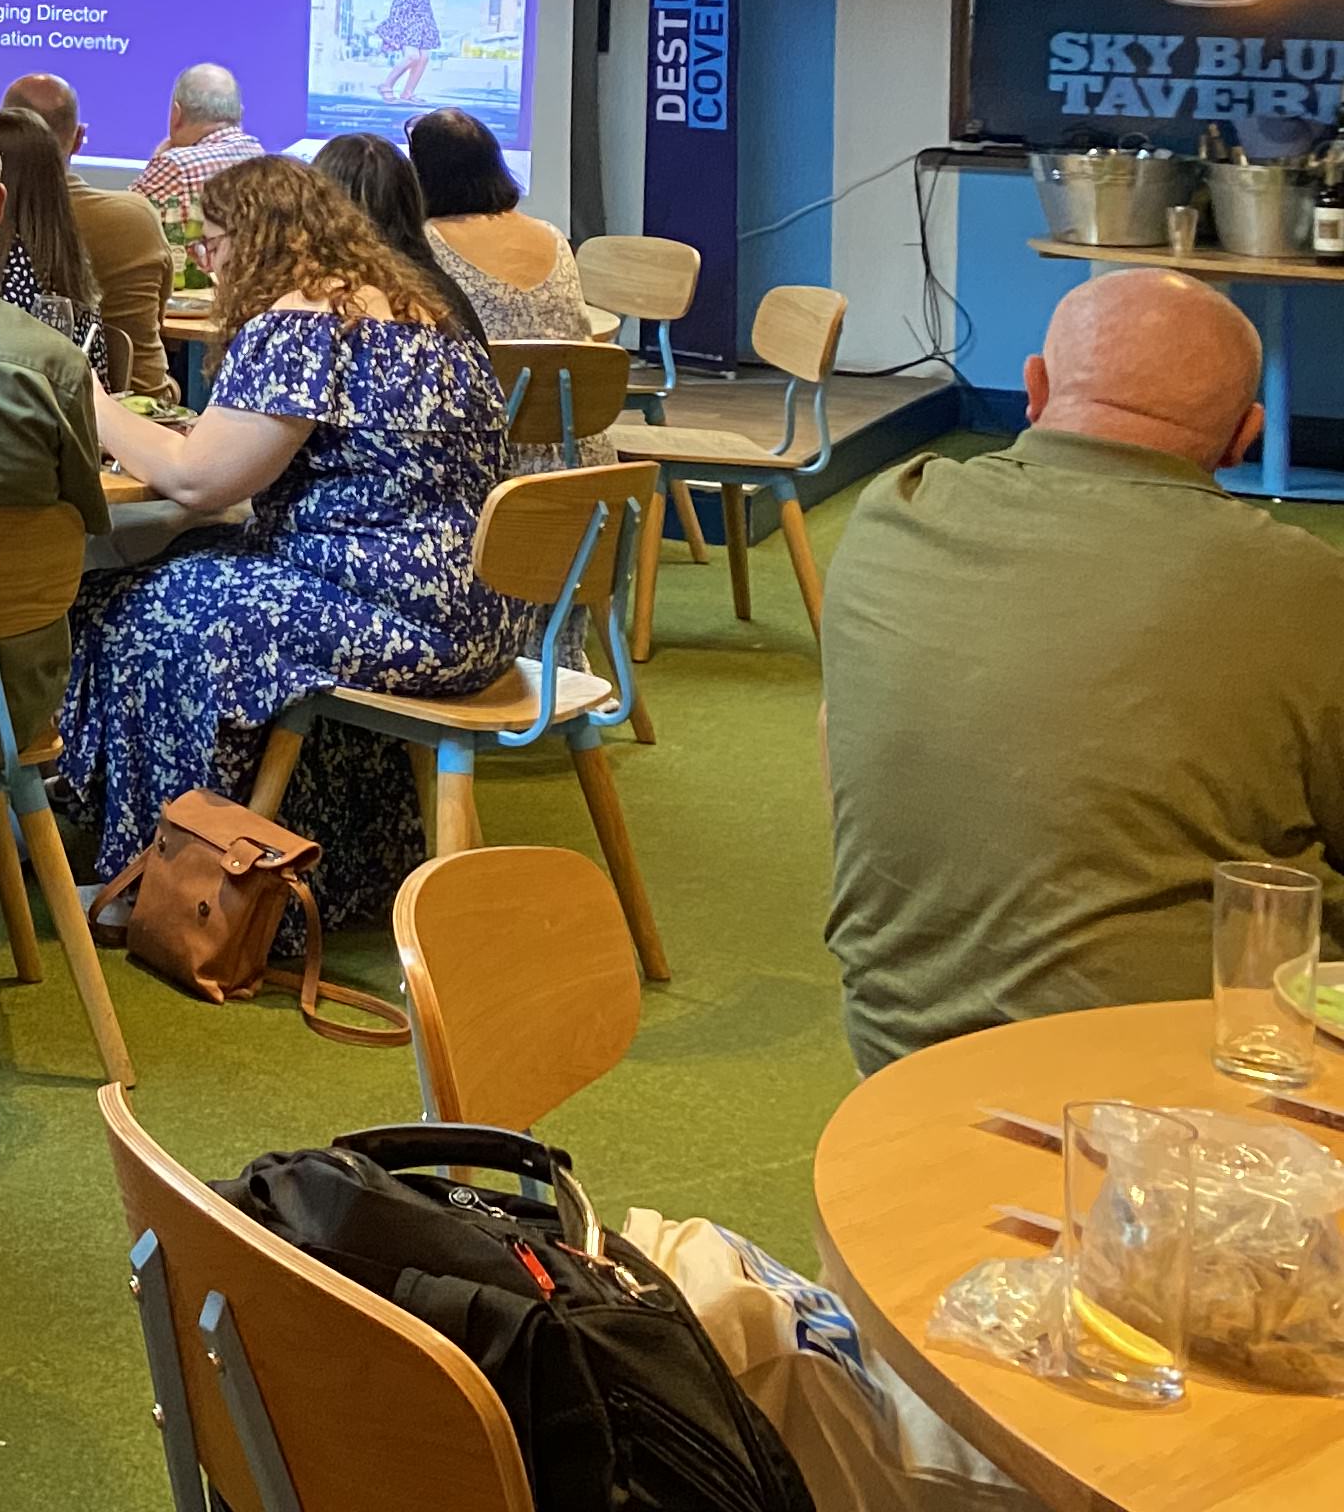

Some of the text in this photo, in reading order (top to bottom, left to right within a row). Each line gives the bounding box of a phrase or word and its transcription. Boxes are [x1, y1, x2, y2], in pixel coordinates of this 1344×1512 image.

[37, 4, 108, 23] Director
[48, 32, 130, 55] Coventry
[1049, 31, 1344, 81] SKY BLU
